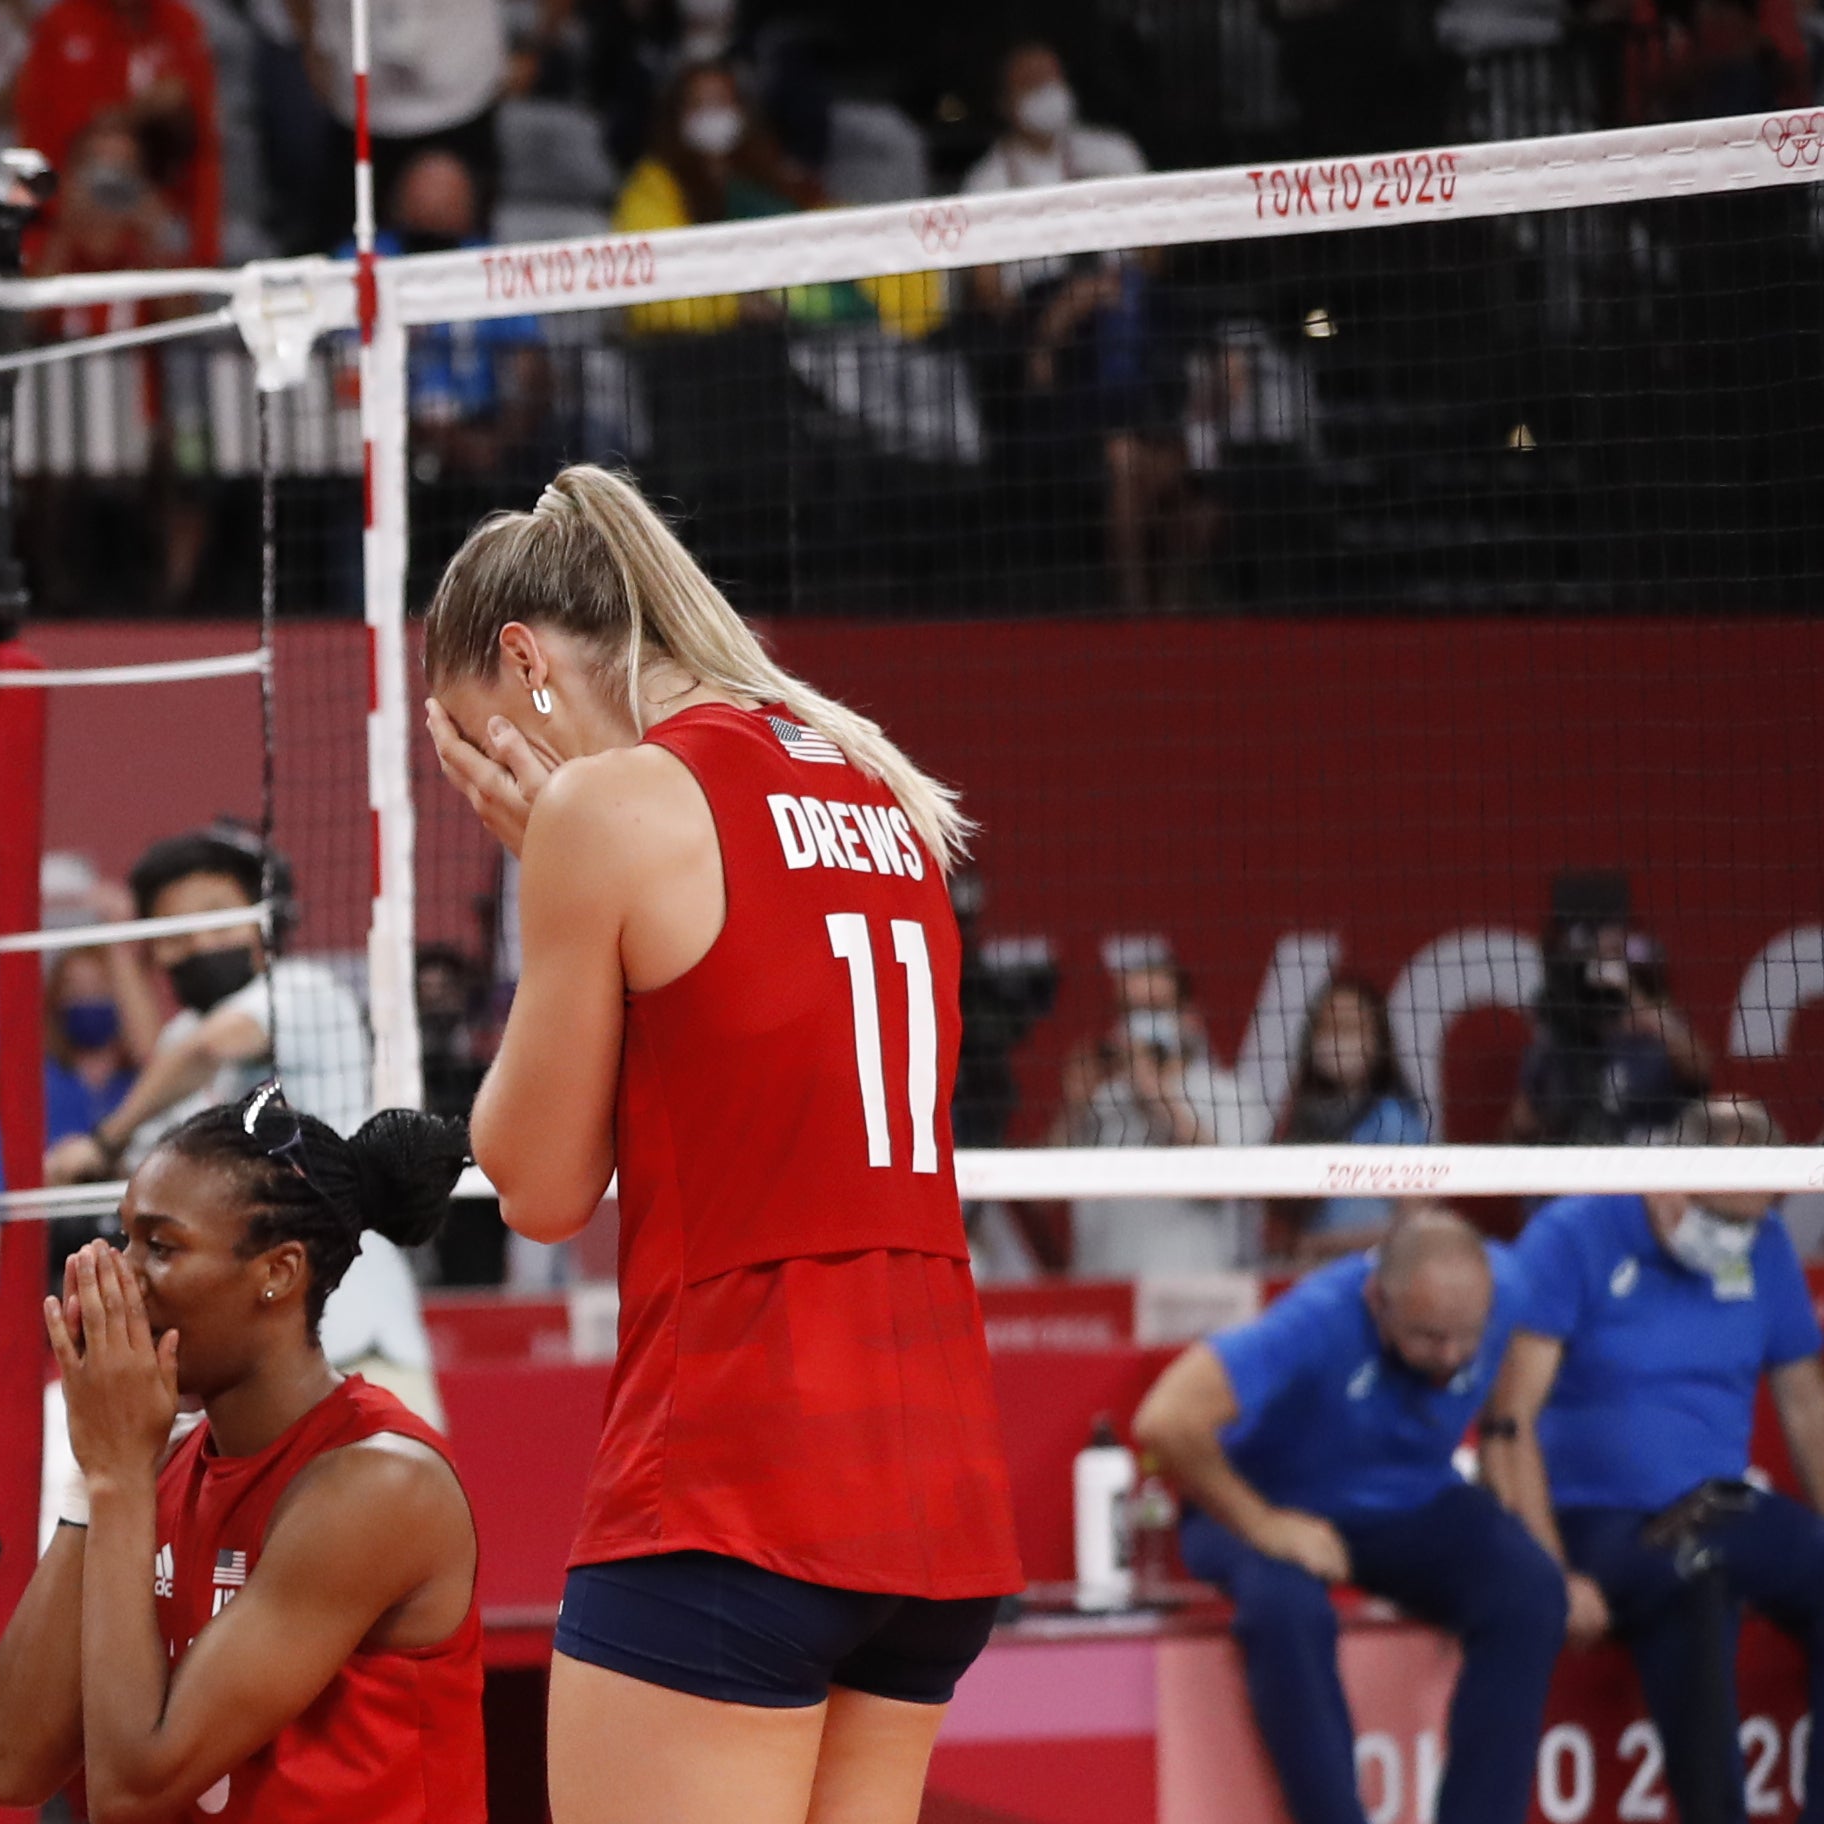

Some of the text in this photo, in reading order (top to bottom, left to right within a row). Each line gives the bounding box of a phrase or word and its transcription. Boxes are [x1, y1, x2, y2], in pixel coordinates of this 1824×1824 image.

[1247, 153, 1458, 219] TOKYO 2020
[482, 241, 656, 299] TOKYO 2020
[767, 794, 925, 882] DREWS
[825, 912, 938, 1174] 11
